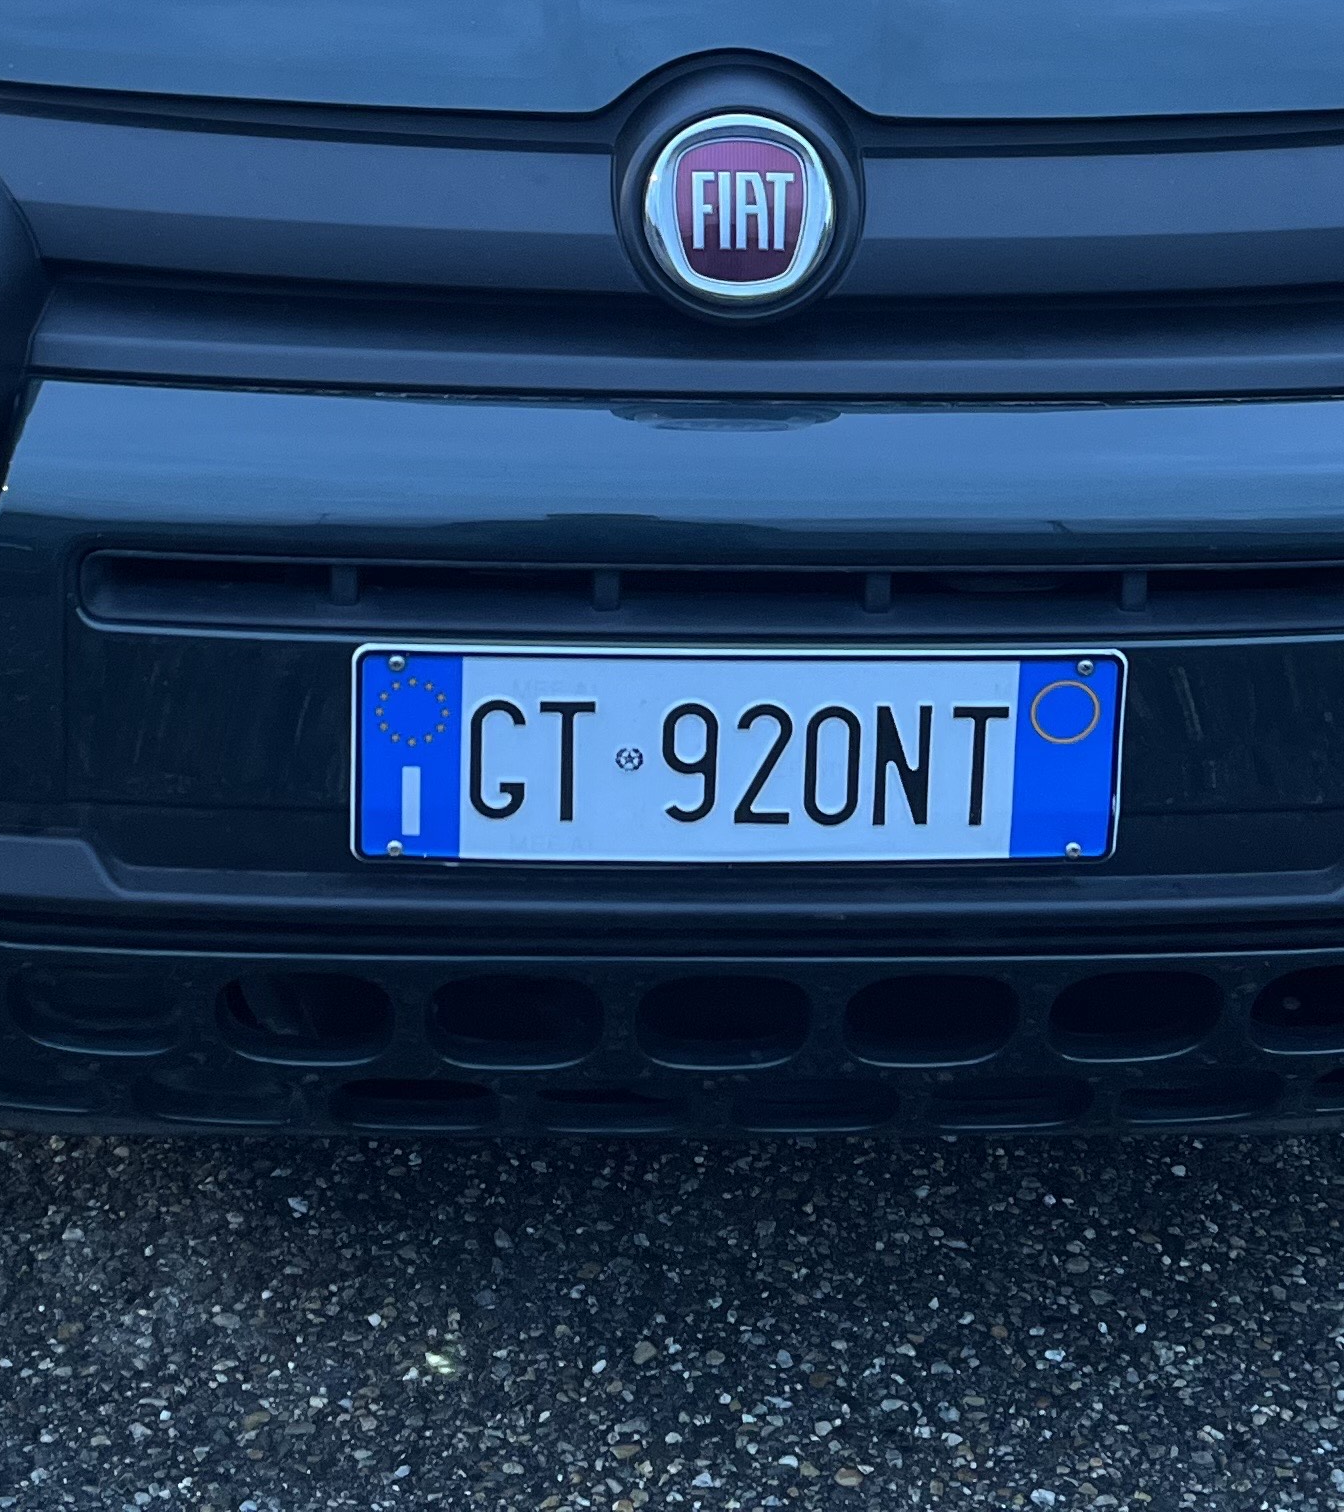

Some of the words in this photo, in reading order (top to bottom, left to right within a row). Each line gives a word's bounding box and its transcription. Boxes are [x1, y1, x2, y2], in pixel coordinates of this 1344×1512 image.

[691, 170, 795, 252] FIAT
[468, 698, 597, 822] GT
[661, 701, 1010, 827] 920NT
